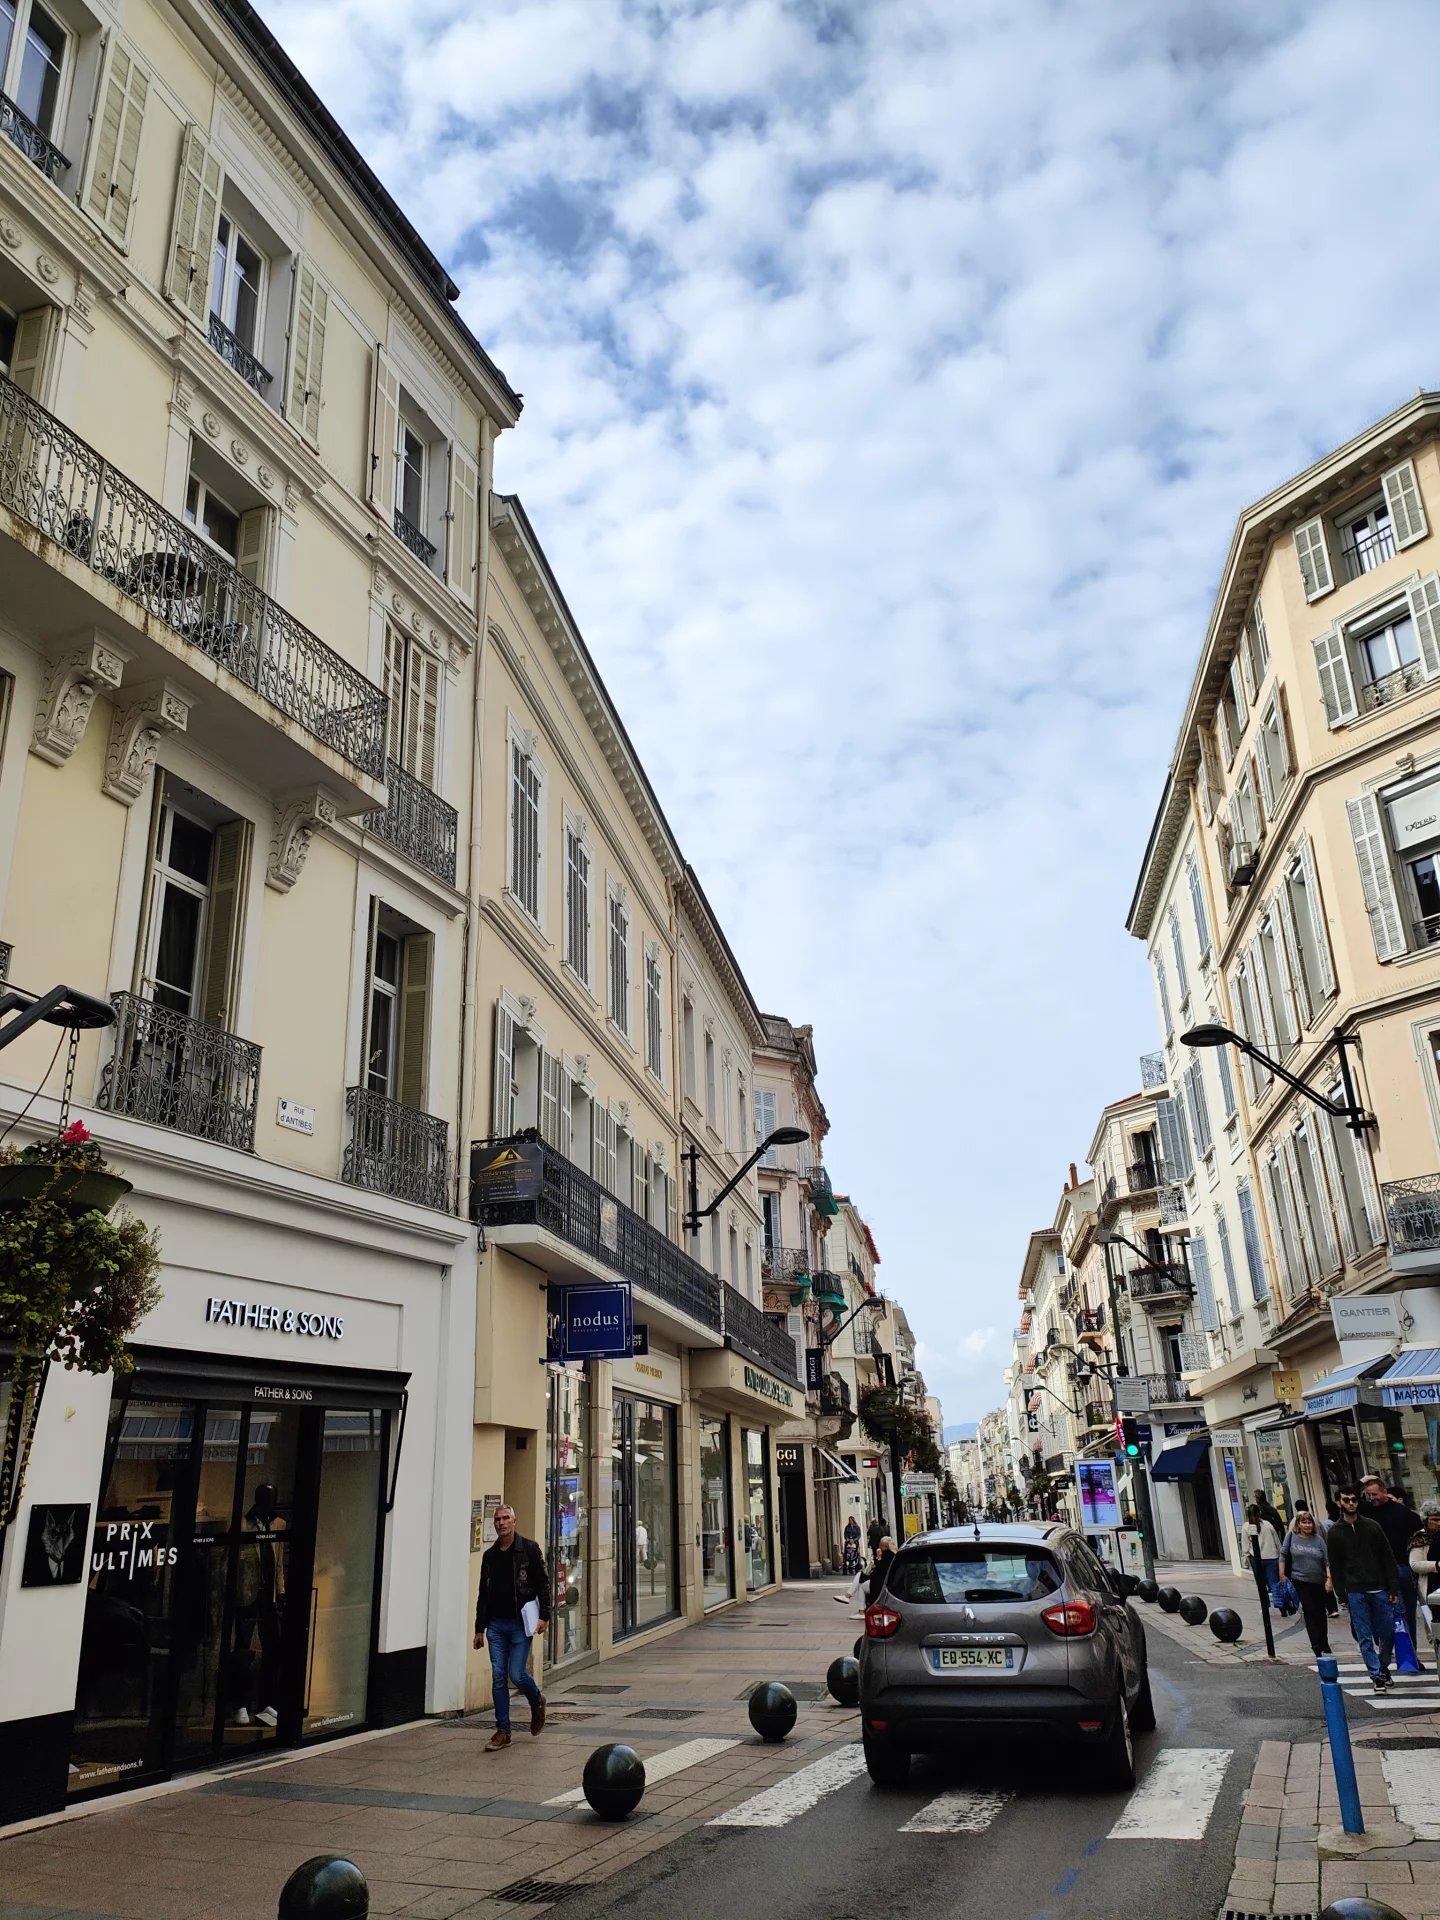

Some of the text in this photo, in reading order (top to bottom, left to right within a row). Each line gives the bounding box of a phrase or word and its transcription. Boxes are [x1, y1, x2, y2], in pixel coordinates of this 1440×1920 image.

[293, 1105, 305, 1116] RUE
[280, 1114, 313, 1131] d'ANTIBES
[206, 1297, 345, 1339] FATHER & SONS
[573, 1310, 619, 1327] nodus
[1339, 1307, 1391, 1318] GANTIER
[809, 1357, 817, 1382] BOGGI
[254, 1385, 313, 1401] FATHER & SONS
[776, 1449, 797, 1460] GGI
[310, 1711, 354, 1729] www.fatherandsons.fr
[79, 1758, 144, 1781] www.fatherandsons.fr
